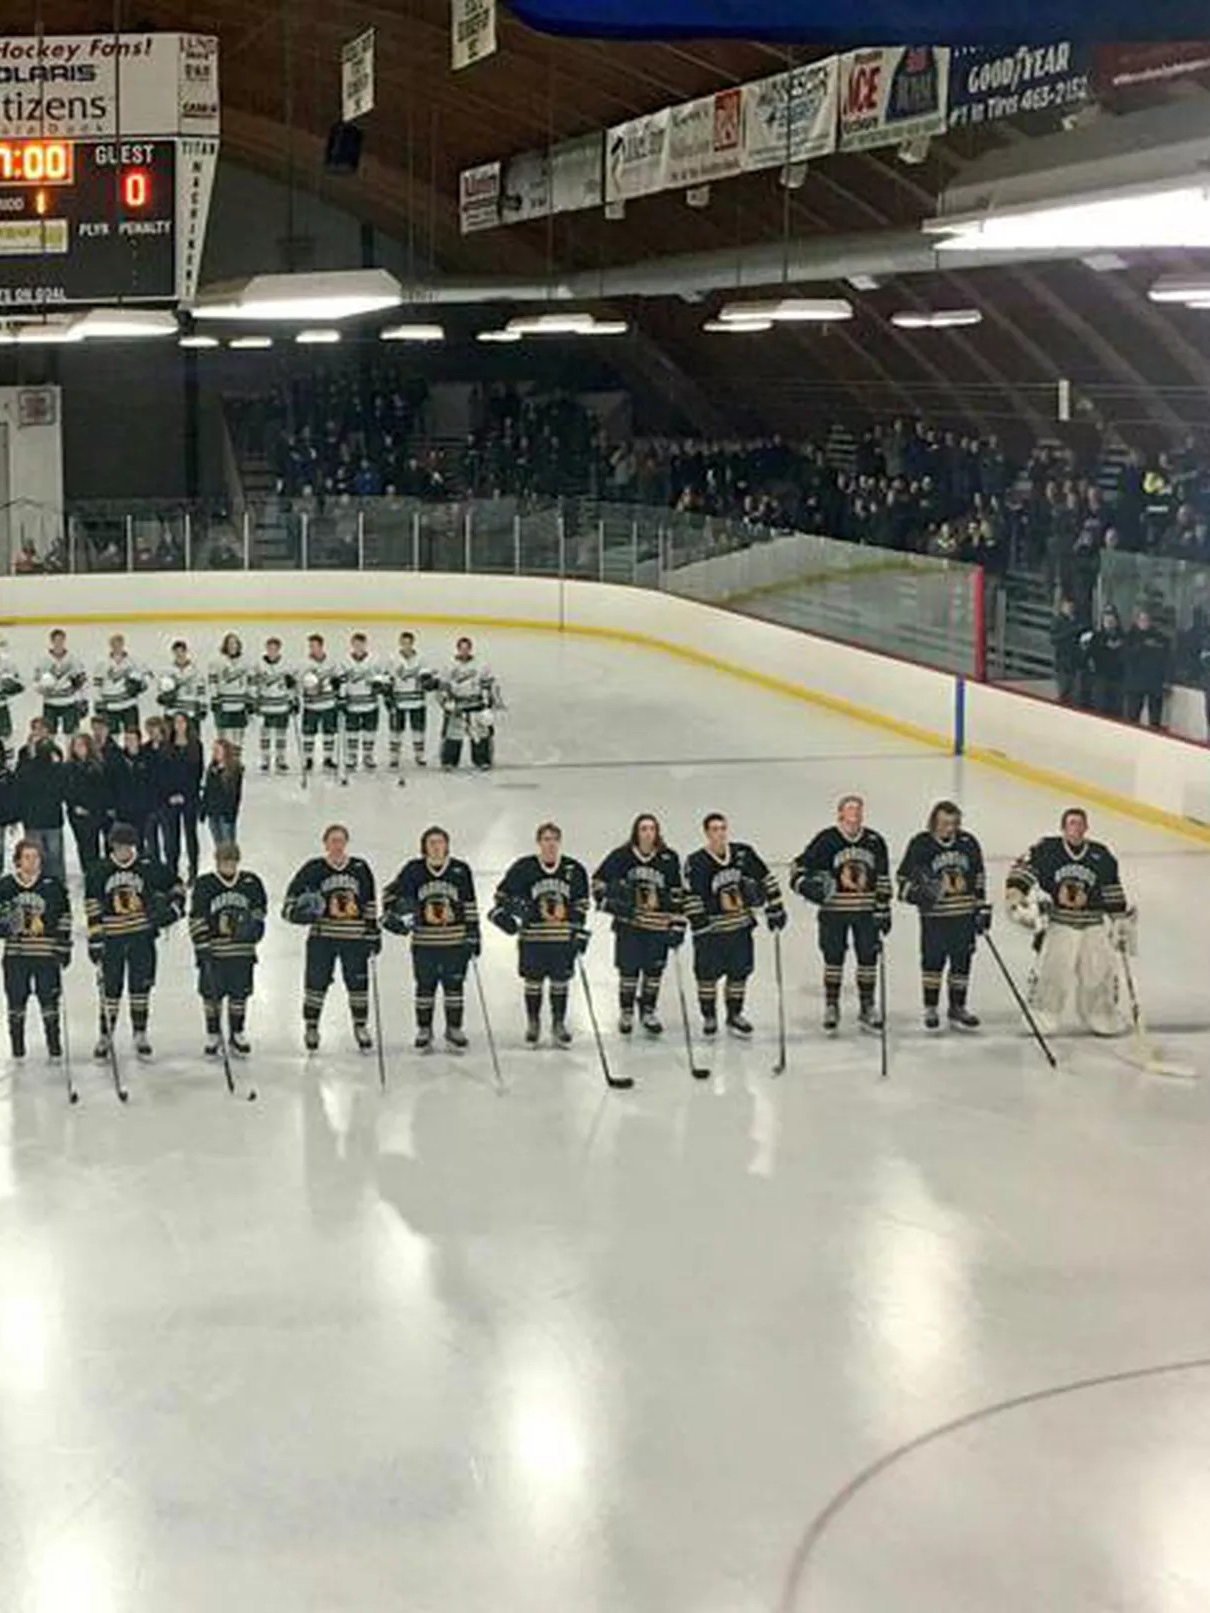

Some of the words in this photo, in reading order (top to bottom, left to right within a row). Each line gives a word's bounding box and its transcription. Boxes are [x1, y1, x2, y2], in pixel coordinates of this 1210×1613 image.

[90, 36, 153, 57] Fans!
[968, 42, 1071, 93] GOODYEAR
[95, 145, 154, 165] GUEST
[125, 174, 145, 206] 0
[36, 192, 46, 214] 1
[78, 223, 109, 238] PLYR
[118, 221, 172, 236] PENALTY
[35, 286, 64, 302] GOAL
